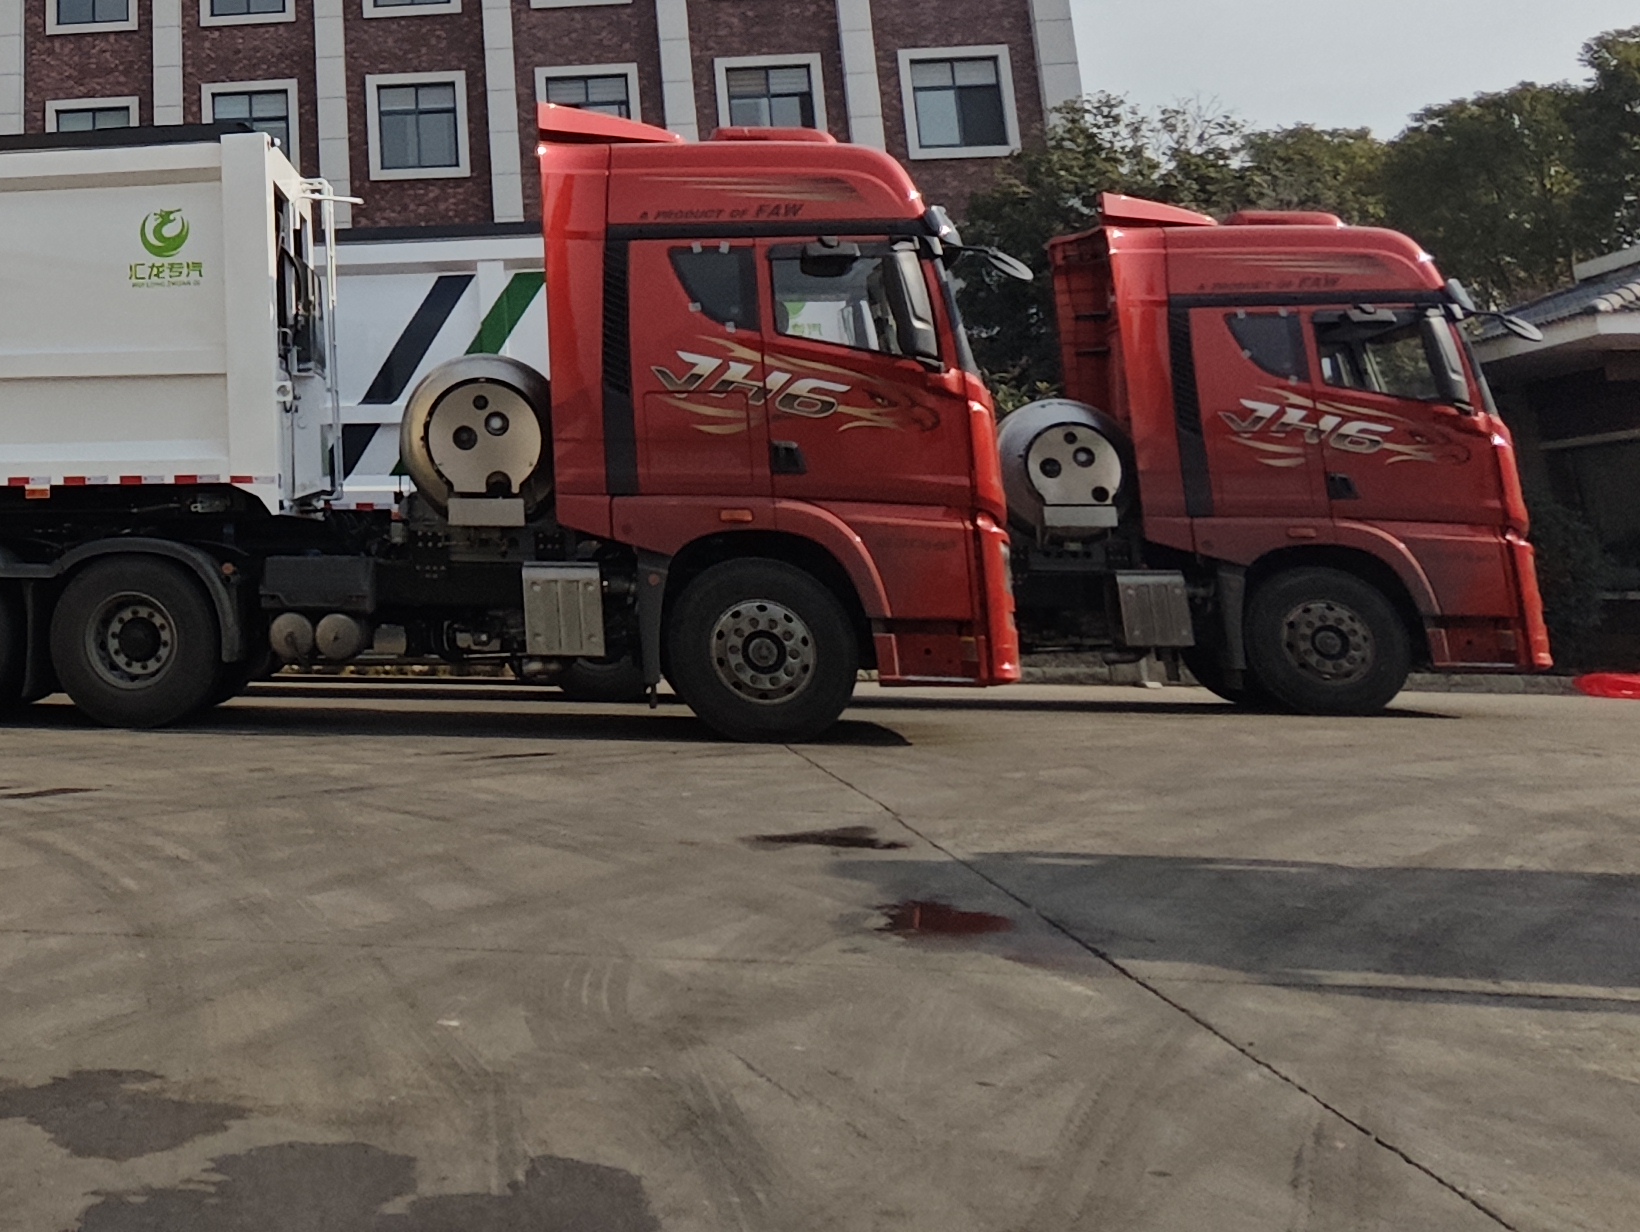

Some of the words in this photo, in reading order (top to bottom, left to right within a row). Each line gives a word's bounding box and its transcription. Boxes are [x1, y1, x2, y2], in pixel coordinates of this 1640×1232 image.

[653, 208, 725, 220] PRODUCT
[755, 203, 805, 218] FAW
[128, 261, 204, 281] 汇龙专汽
[652, 350, 853, 418] JH6
[1218, 399, 1395, 455] JH6
